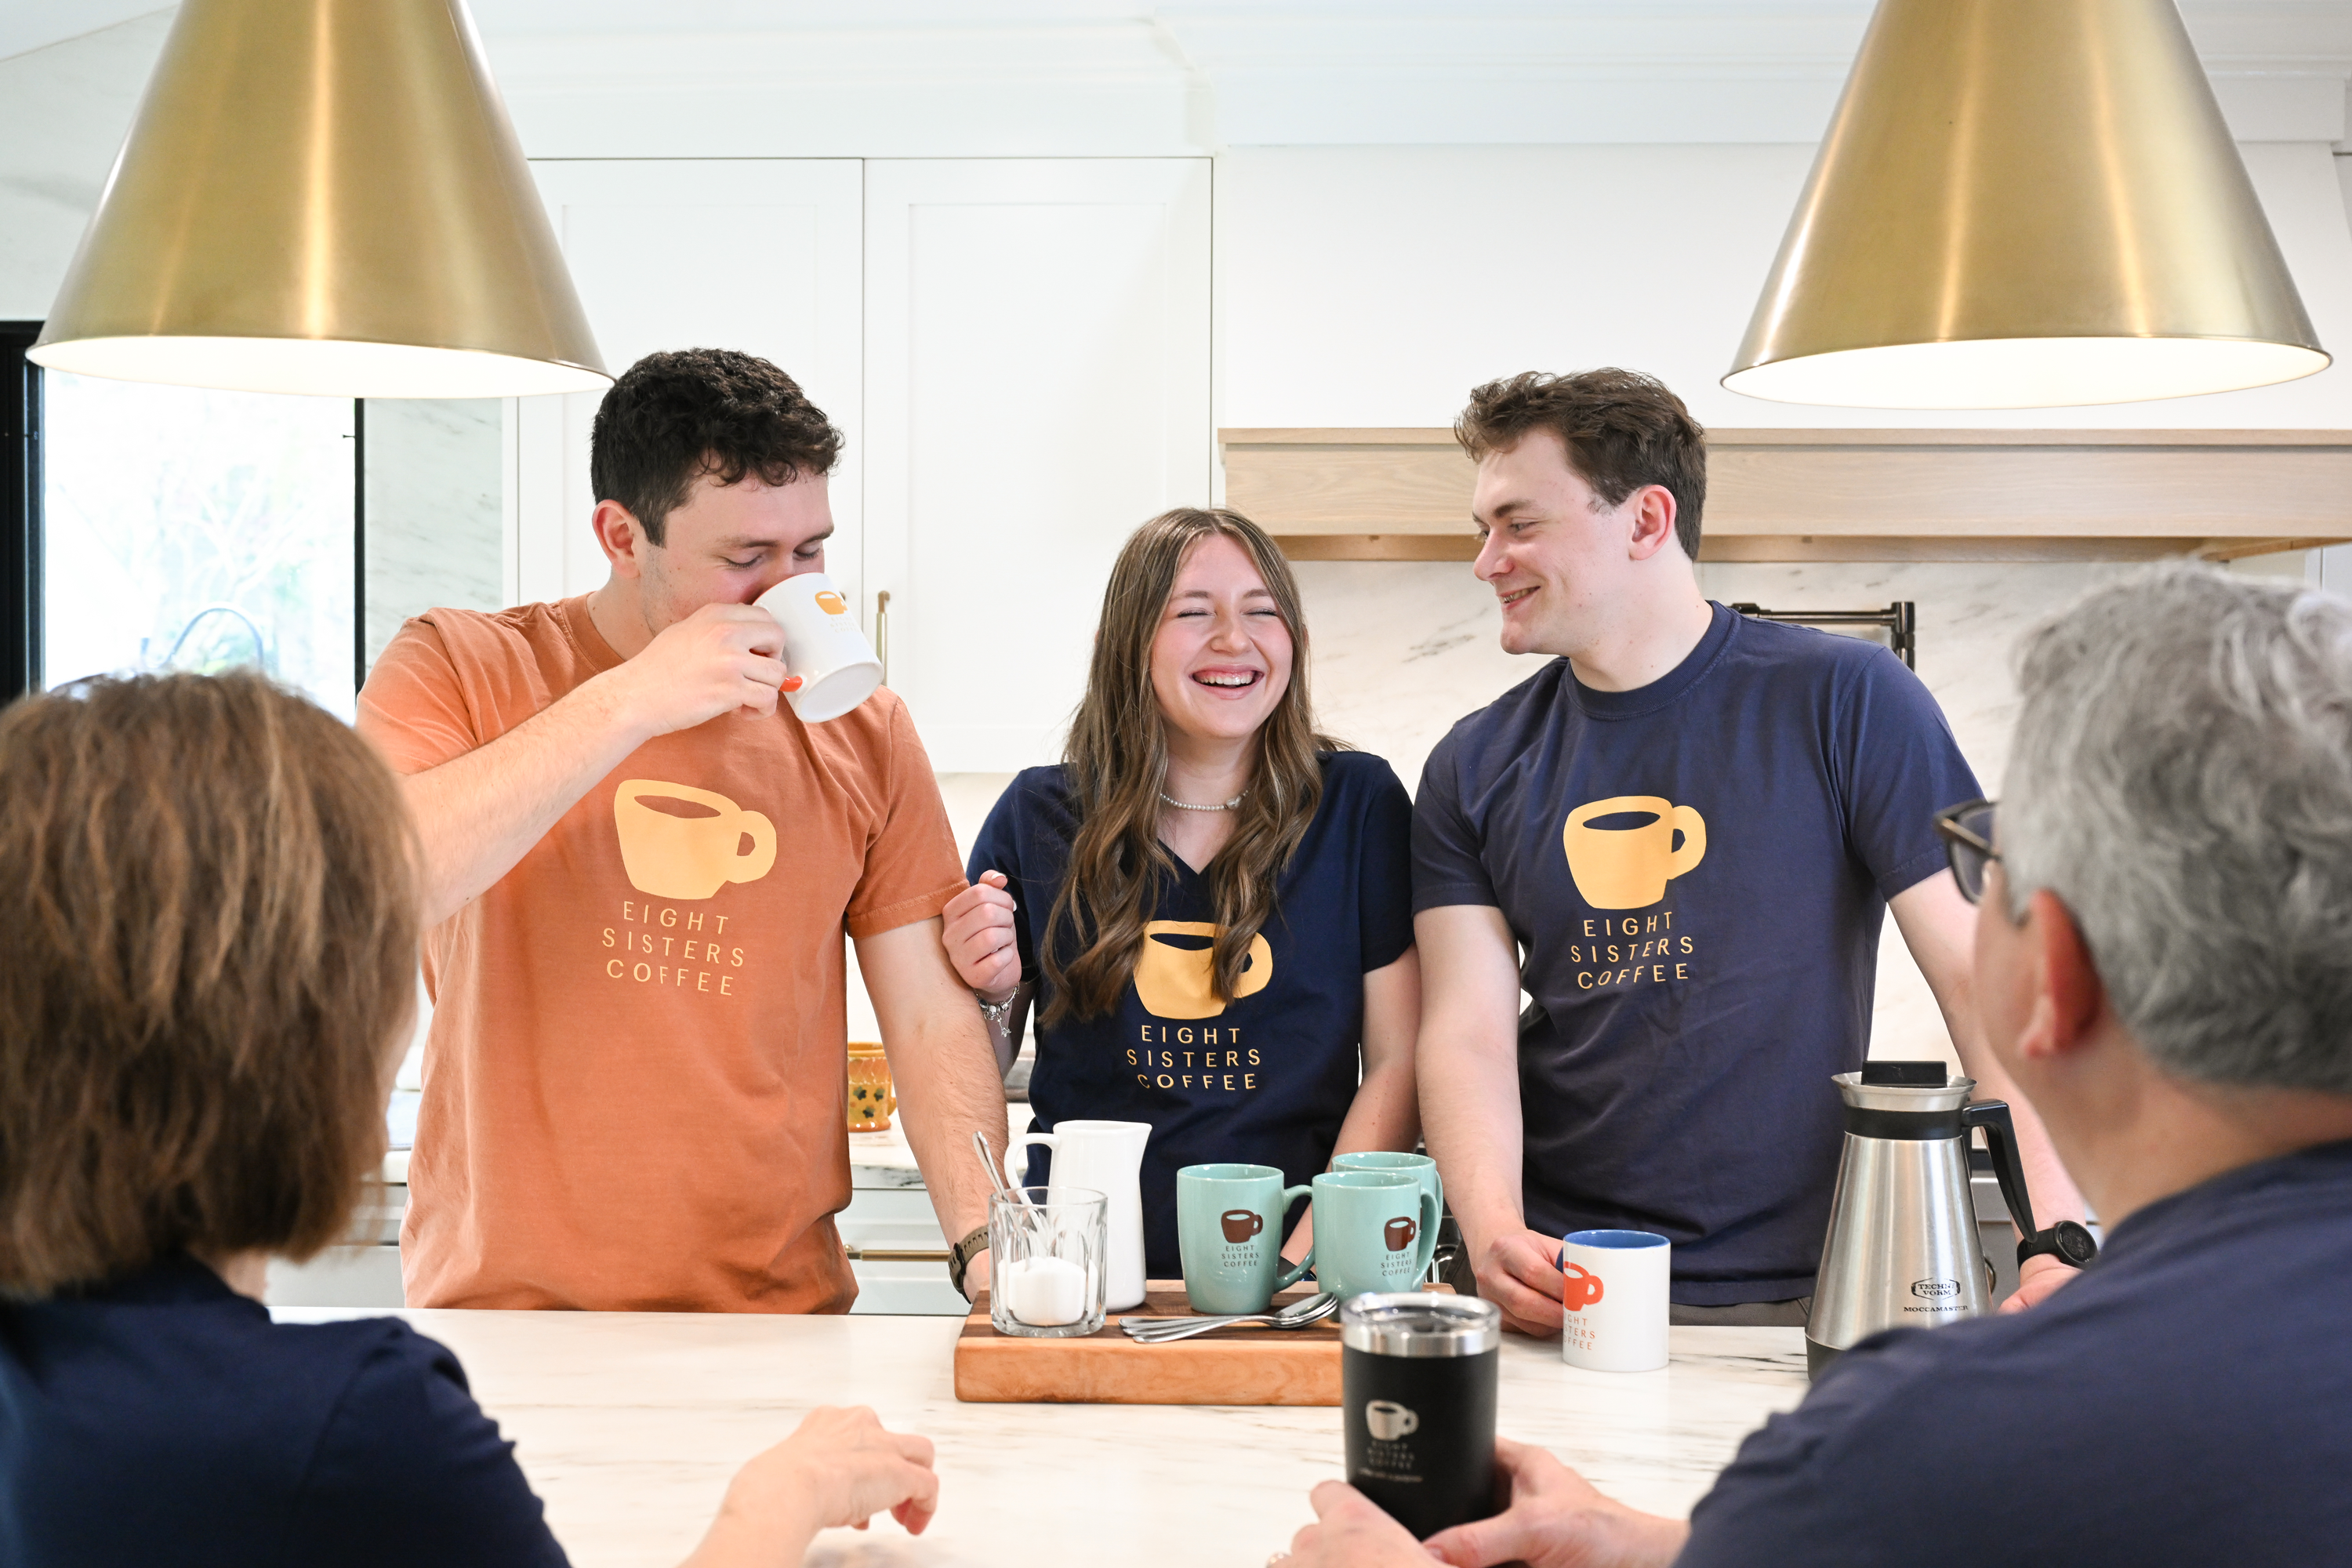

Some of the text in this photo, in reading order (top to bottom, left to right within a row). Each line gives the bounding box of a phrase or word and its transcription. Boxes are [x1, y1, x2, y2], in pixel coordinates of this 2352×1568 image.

[623, 900, 729, 935] EIGHT
[1583, 911, 1672, 937] EIGHT
[602, 927, 744, 967] SISTERS
[1570, 936, 1693, 963] SISTERS
[606, 959, 734, 996] COFFEE
[1577, 963, 1689, 989] COFFEE
[1141, 1025, 1240, 1044] EIGHT
[1127, 1048, 1261, 1068] SISTERS
[1137, 1073, 1257, 1091] COFFEE
[1381, 1258, 1412, 1269] SISTERS
[1382, 1267, 1410, 1276] COFFEE
[1564, 1324, 1595, 1339] STERS
[1563, 1334, 1592, 1351] OFFEE
